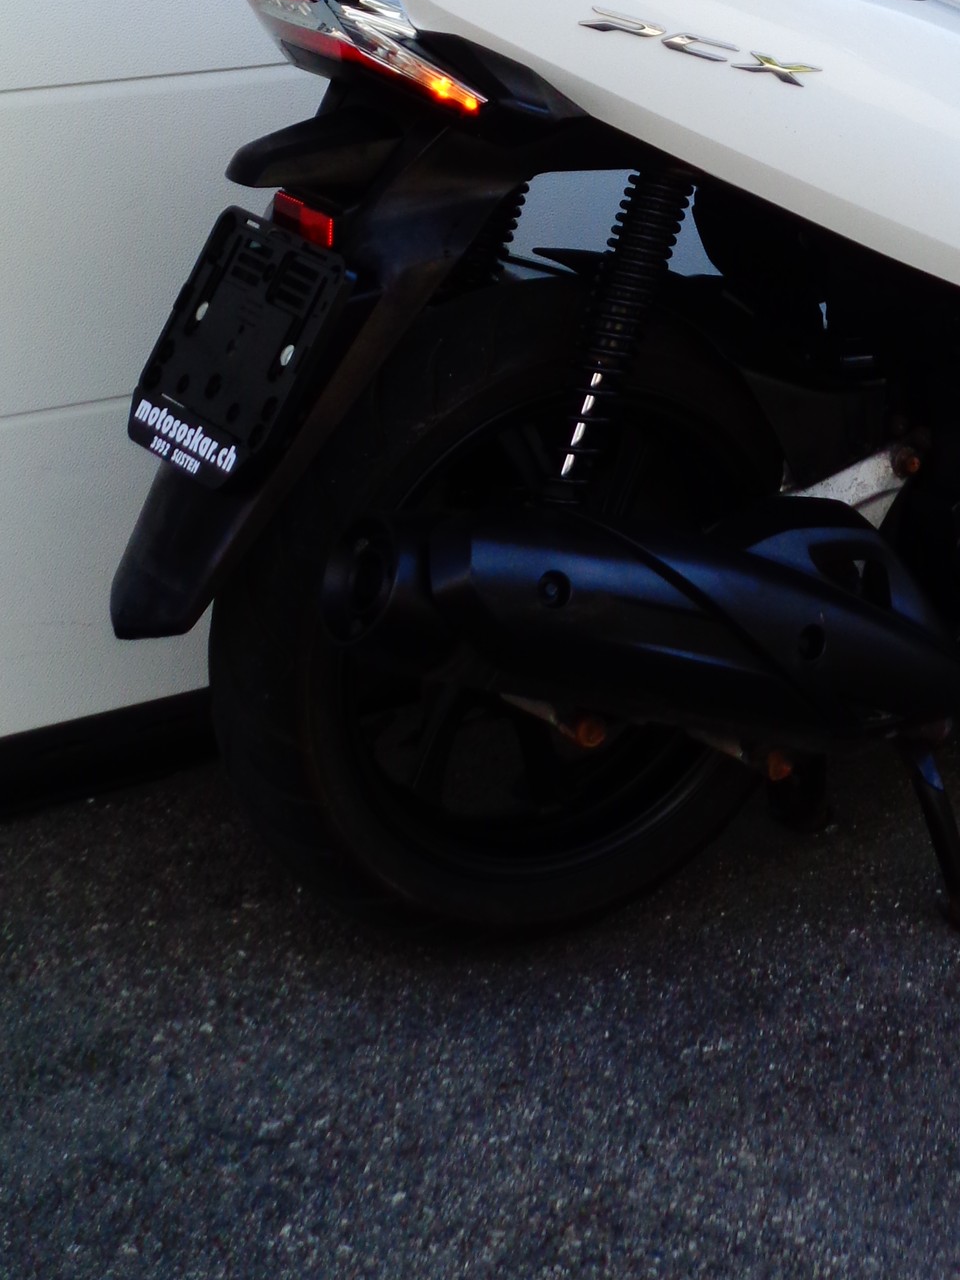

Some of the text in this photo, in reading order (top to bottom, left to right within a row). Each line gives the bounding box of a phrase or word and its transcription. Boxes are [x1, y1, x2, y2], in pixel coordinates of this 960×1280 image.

[577, 5, 823, 87] PCX
[134, 399, 237, 473] motososkar.ch
[171, 448, 201, 475] SUSTEN
